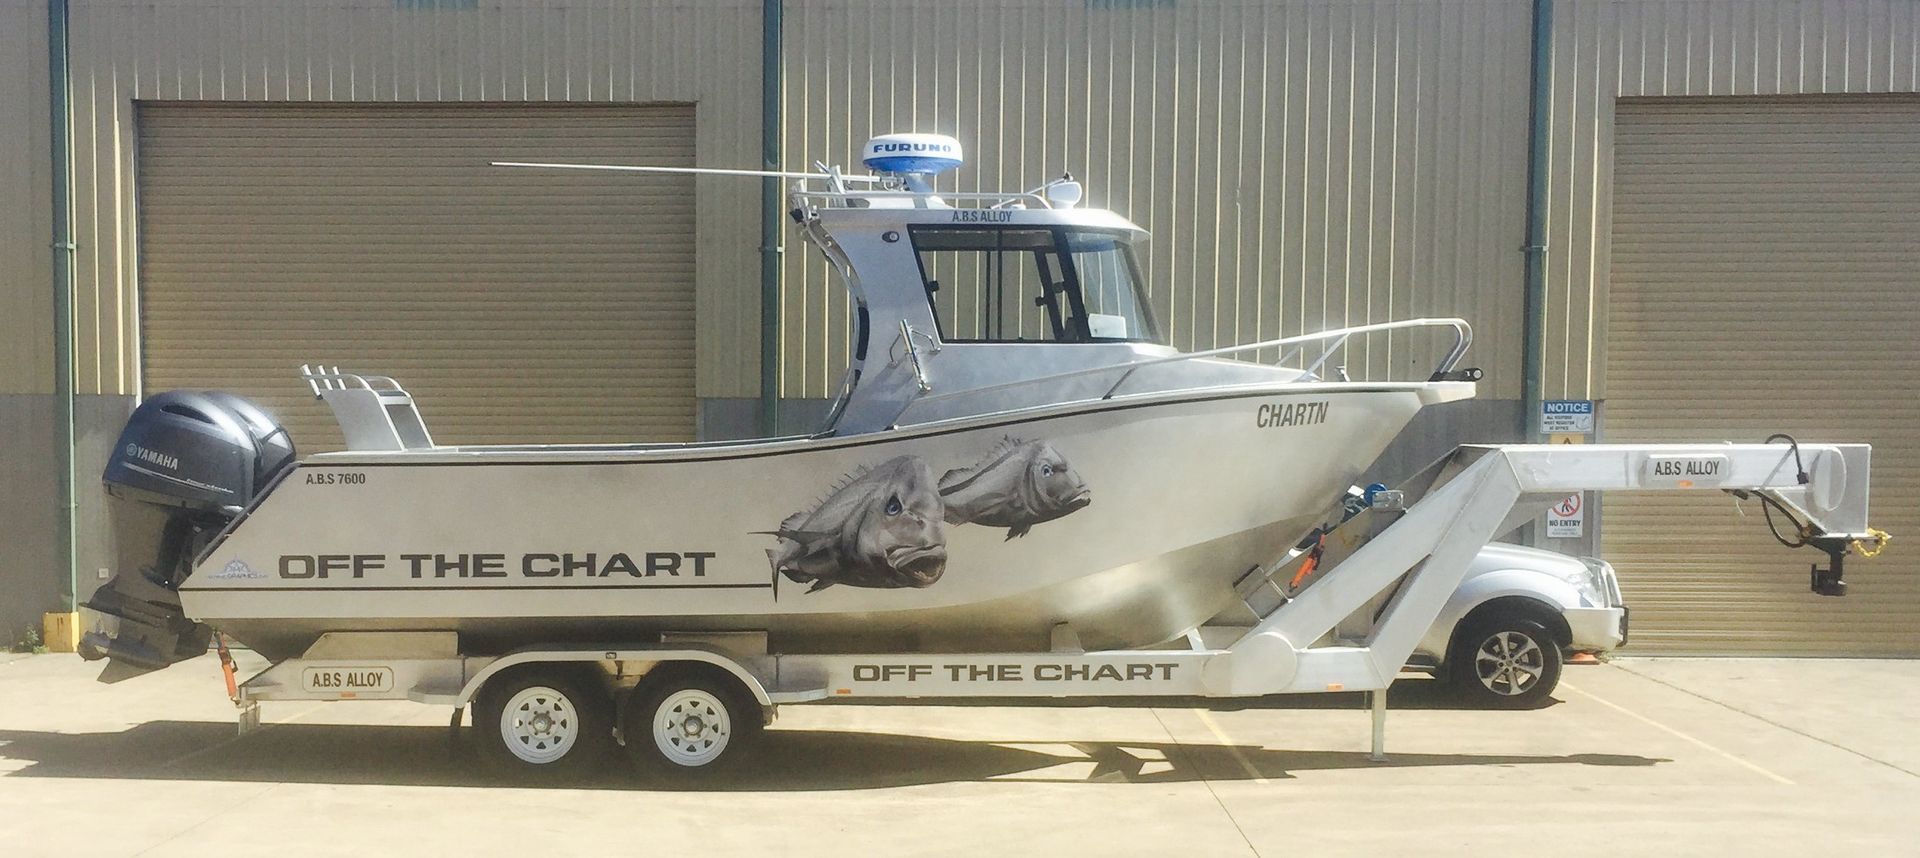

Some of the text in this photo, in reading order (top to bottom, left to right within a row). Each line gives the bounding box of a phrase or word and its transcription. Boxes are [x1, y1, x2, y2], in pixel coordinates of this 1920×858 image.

[873, 143, 951, 153] FURUNO
[952, 211, 1012, 222] A.B.S ALLOY
[1257, 401, 1329, 428] CHARTN
[1547, 403, 1588, 412] NOTICE
[137, 447, 179, 471] YAMAHA
[1654, 461, 1720, 475] A.B.S ALLOY
[306, 473, 366, 484] A.B.S 7600
[279, 552, 716, 579] OFF THE CHART
[312, 672, 383, 687] A.B.S ALLOY
[853, 663, 1180, 682] OFF THE CHART
